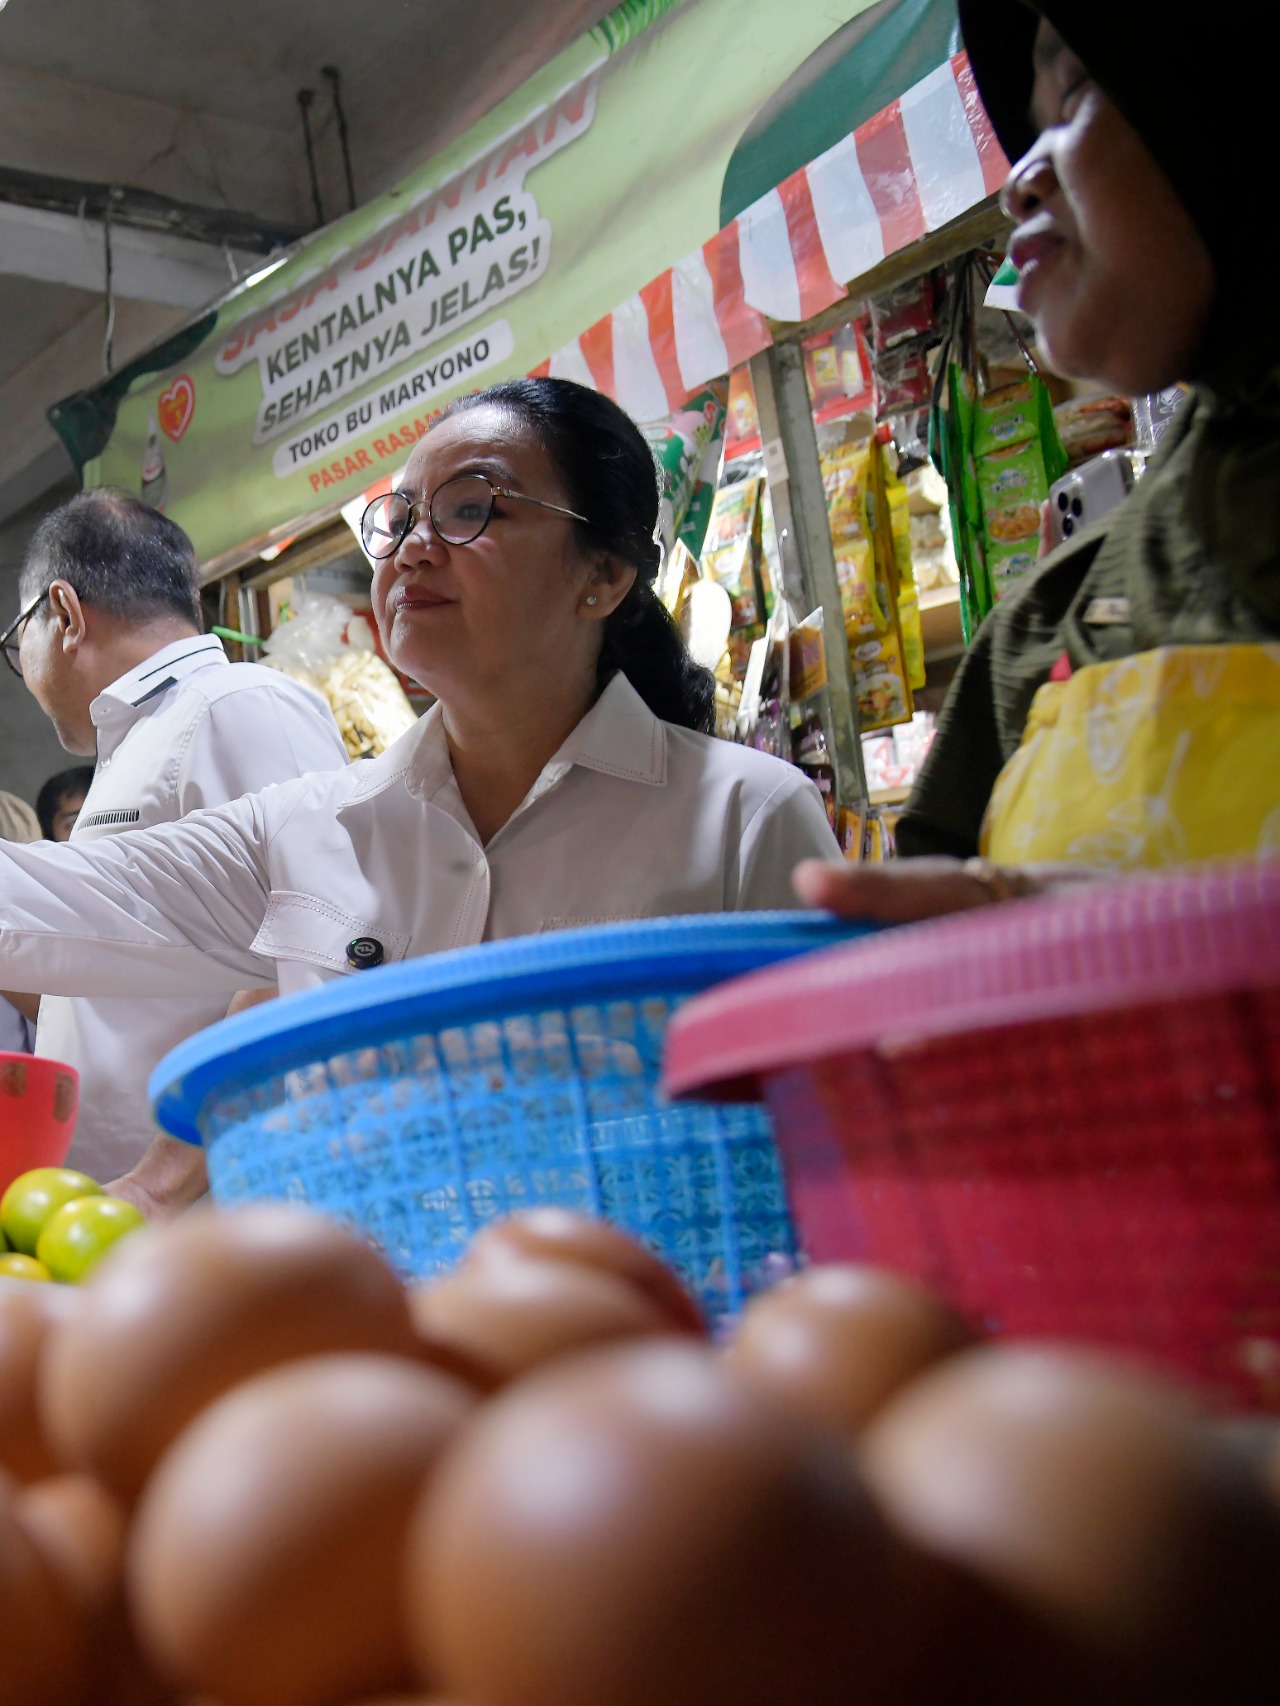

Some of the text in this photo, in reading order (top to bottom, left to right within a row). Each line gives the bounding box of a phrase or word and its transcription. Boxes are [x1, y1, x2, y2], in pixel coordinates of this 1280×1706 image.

[261, 236, 541, 433] SEHATNYA JELAS!
[267, 195, 527, 385] KENTALNYA PAS,
[289, 338, 490, 463] TOKO BU MARYONO
[308, 448, 373, 493] PASAR
